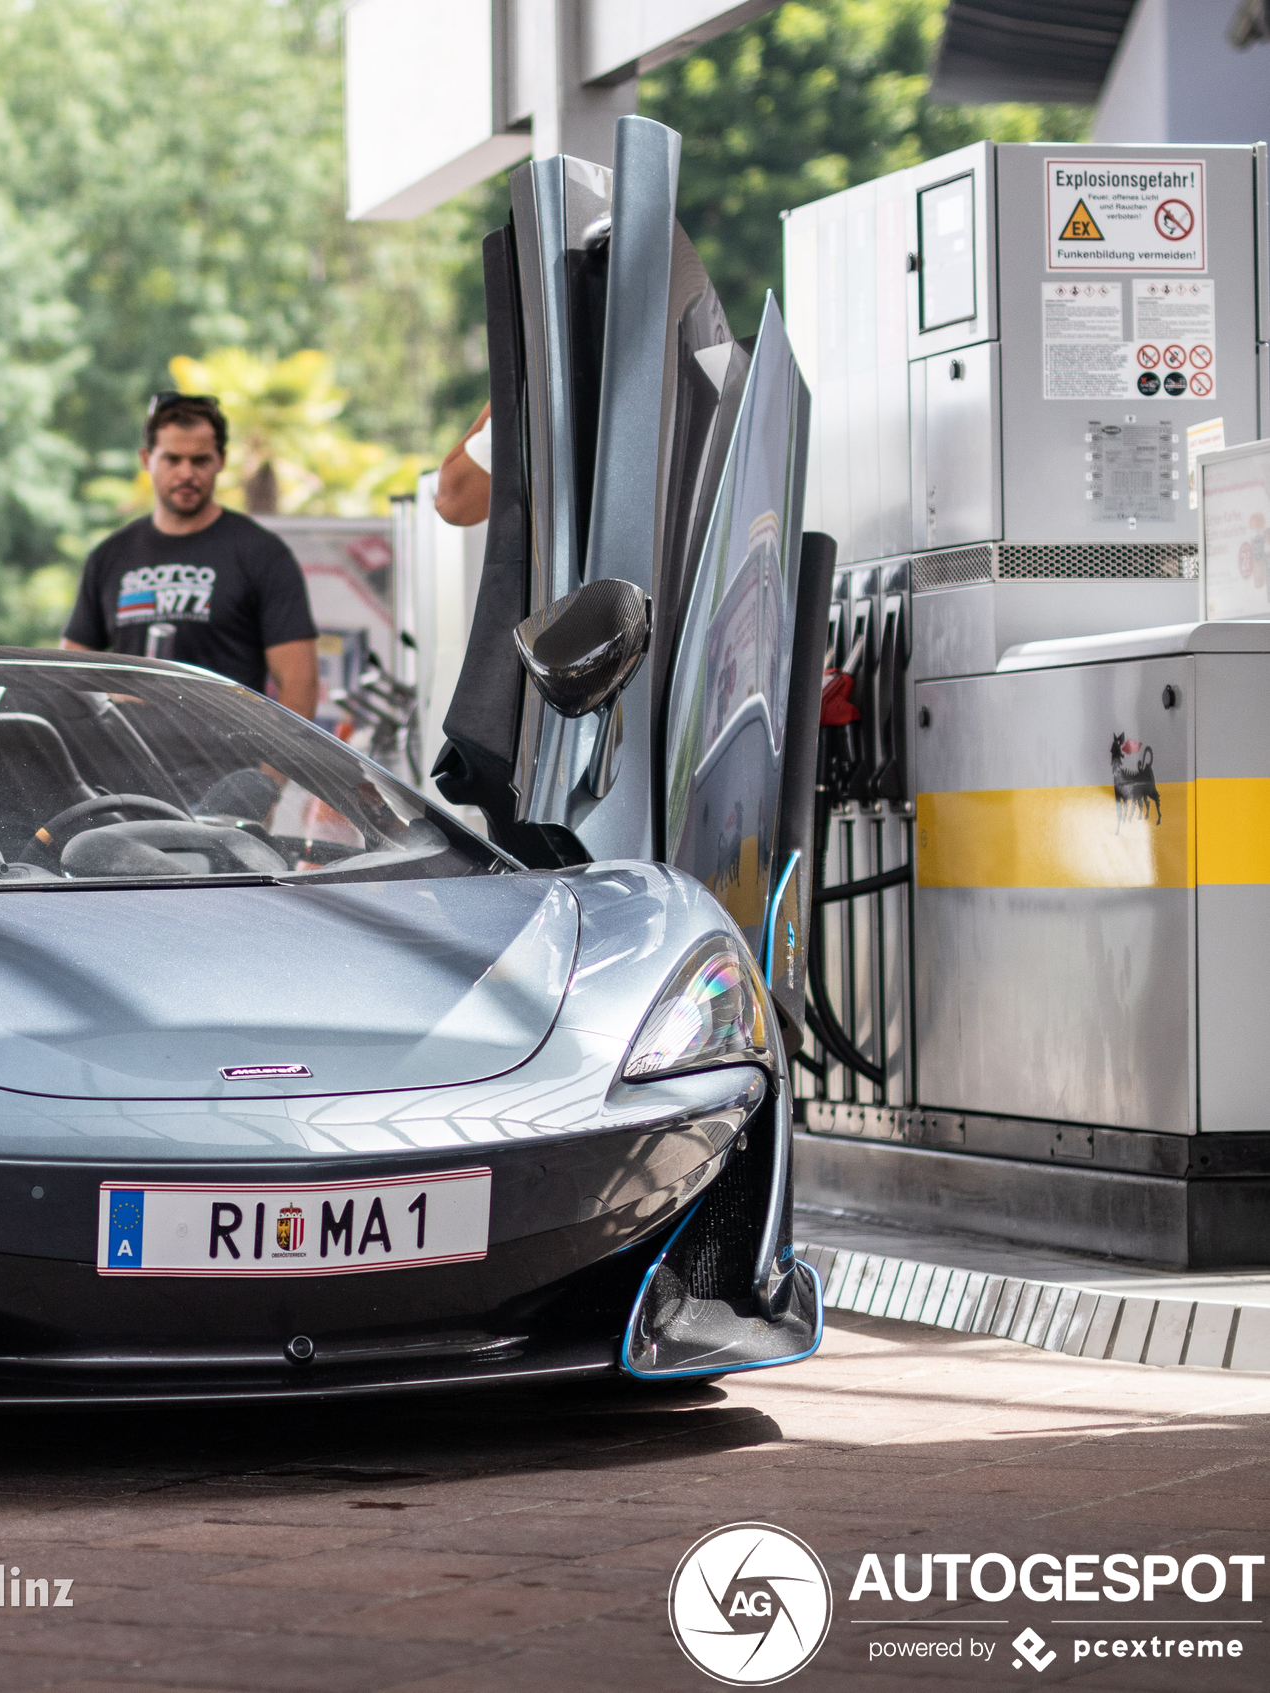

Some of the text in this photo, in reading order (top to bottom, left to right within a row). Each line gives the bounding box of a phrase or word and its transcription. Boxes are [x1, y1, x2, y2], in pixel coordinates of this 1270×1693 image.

[1056, 170, 1195, 191] Explosionsgefahr!
[1112, 193, 1139, 201] offenes
[1072, 221, 1091, 236] EX
[1057, 249, 1196, 262] Funkenbildung vermeiden!
[121, 563, 216, 590] sparco
[209, 1192, 427, 1260] RI MA 1
[117, 1239, 133, 1257] A
